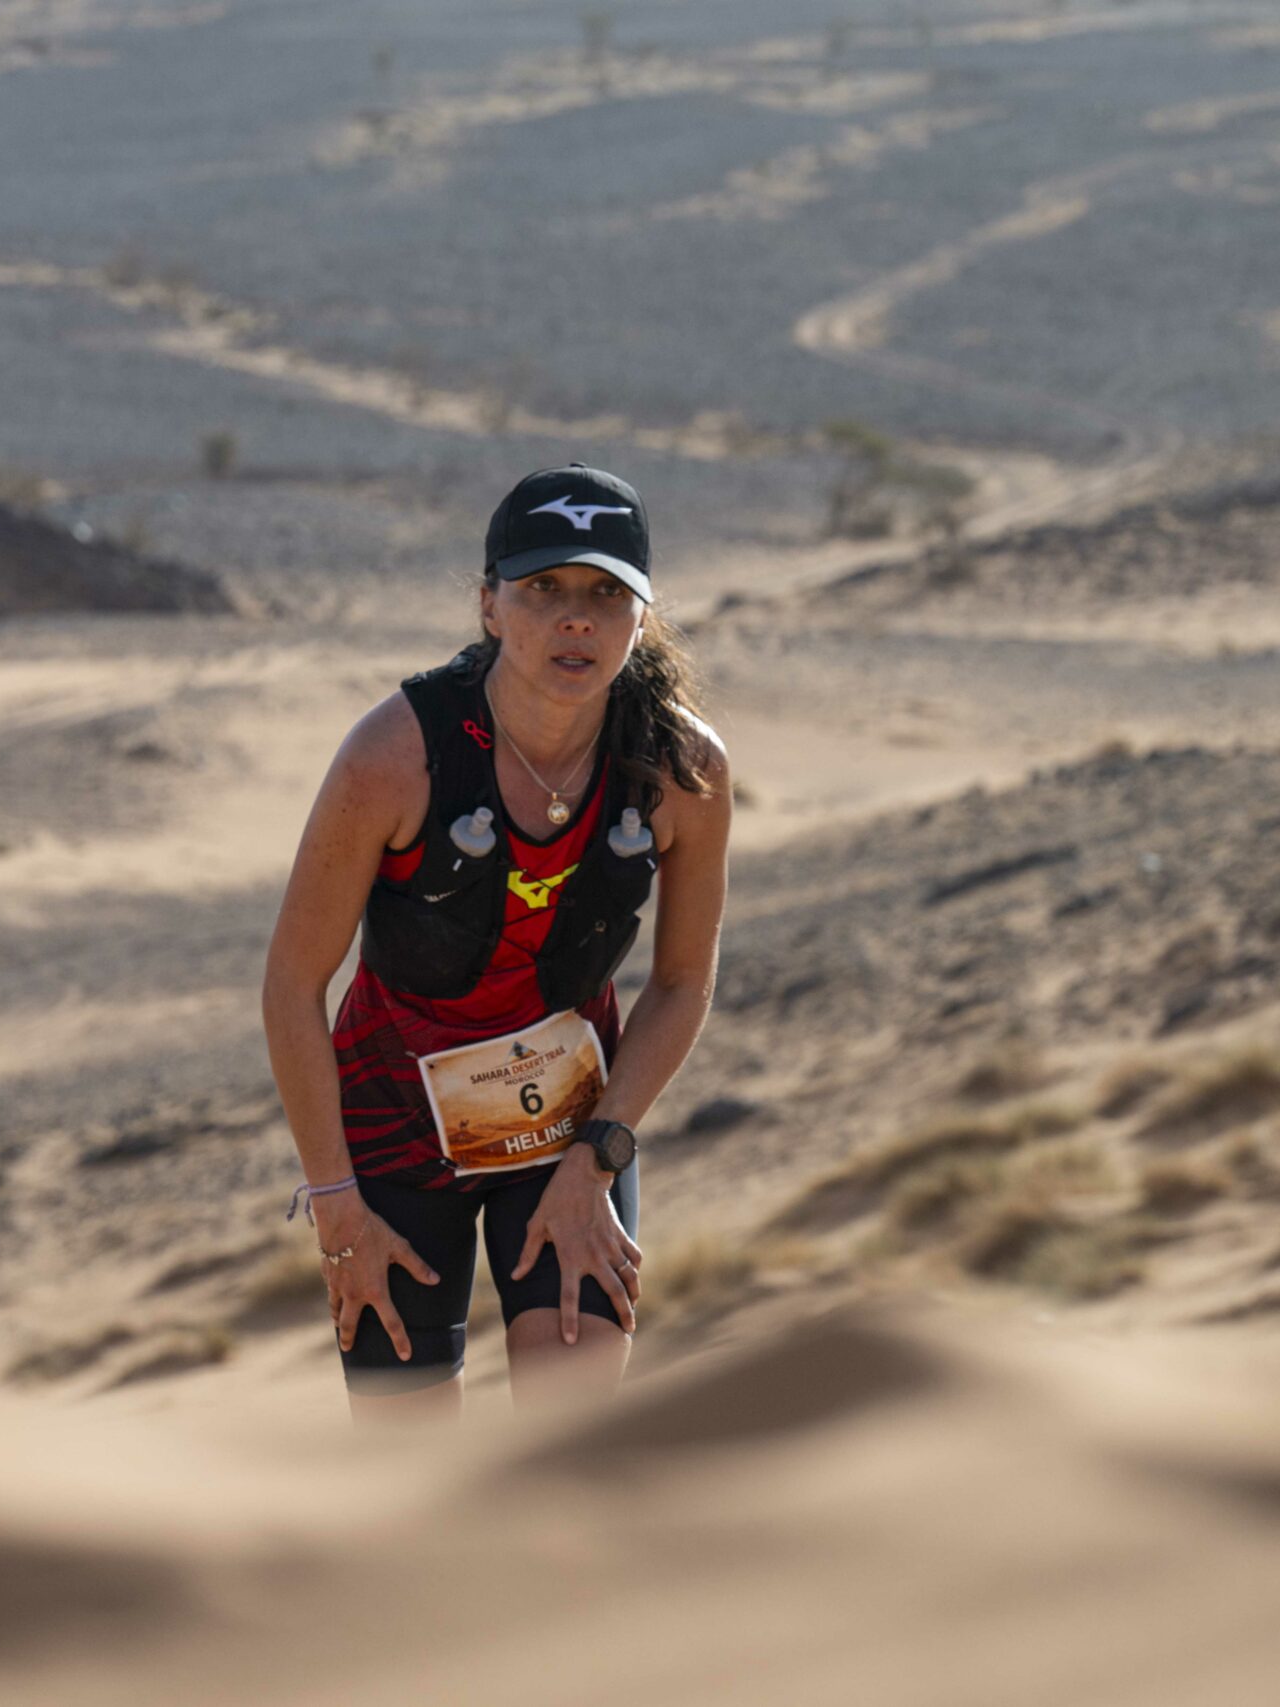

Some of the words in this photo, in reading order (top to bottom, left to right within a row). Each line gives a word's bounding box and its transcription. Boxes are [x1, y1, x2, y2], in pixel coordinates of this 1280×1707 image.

[470, 1067, 511, 1084] SAHARA
[512, 1057, 545, 1074] DESERT
[545, 1045, 566, 1063] TRAIL
[504, 1069, 545, 1086] MOROCCO
[519, 1083, 544, 1114] 6
[505, 1117, 575, 1154] HELINE
